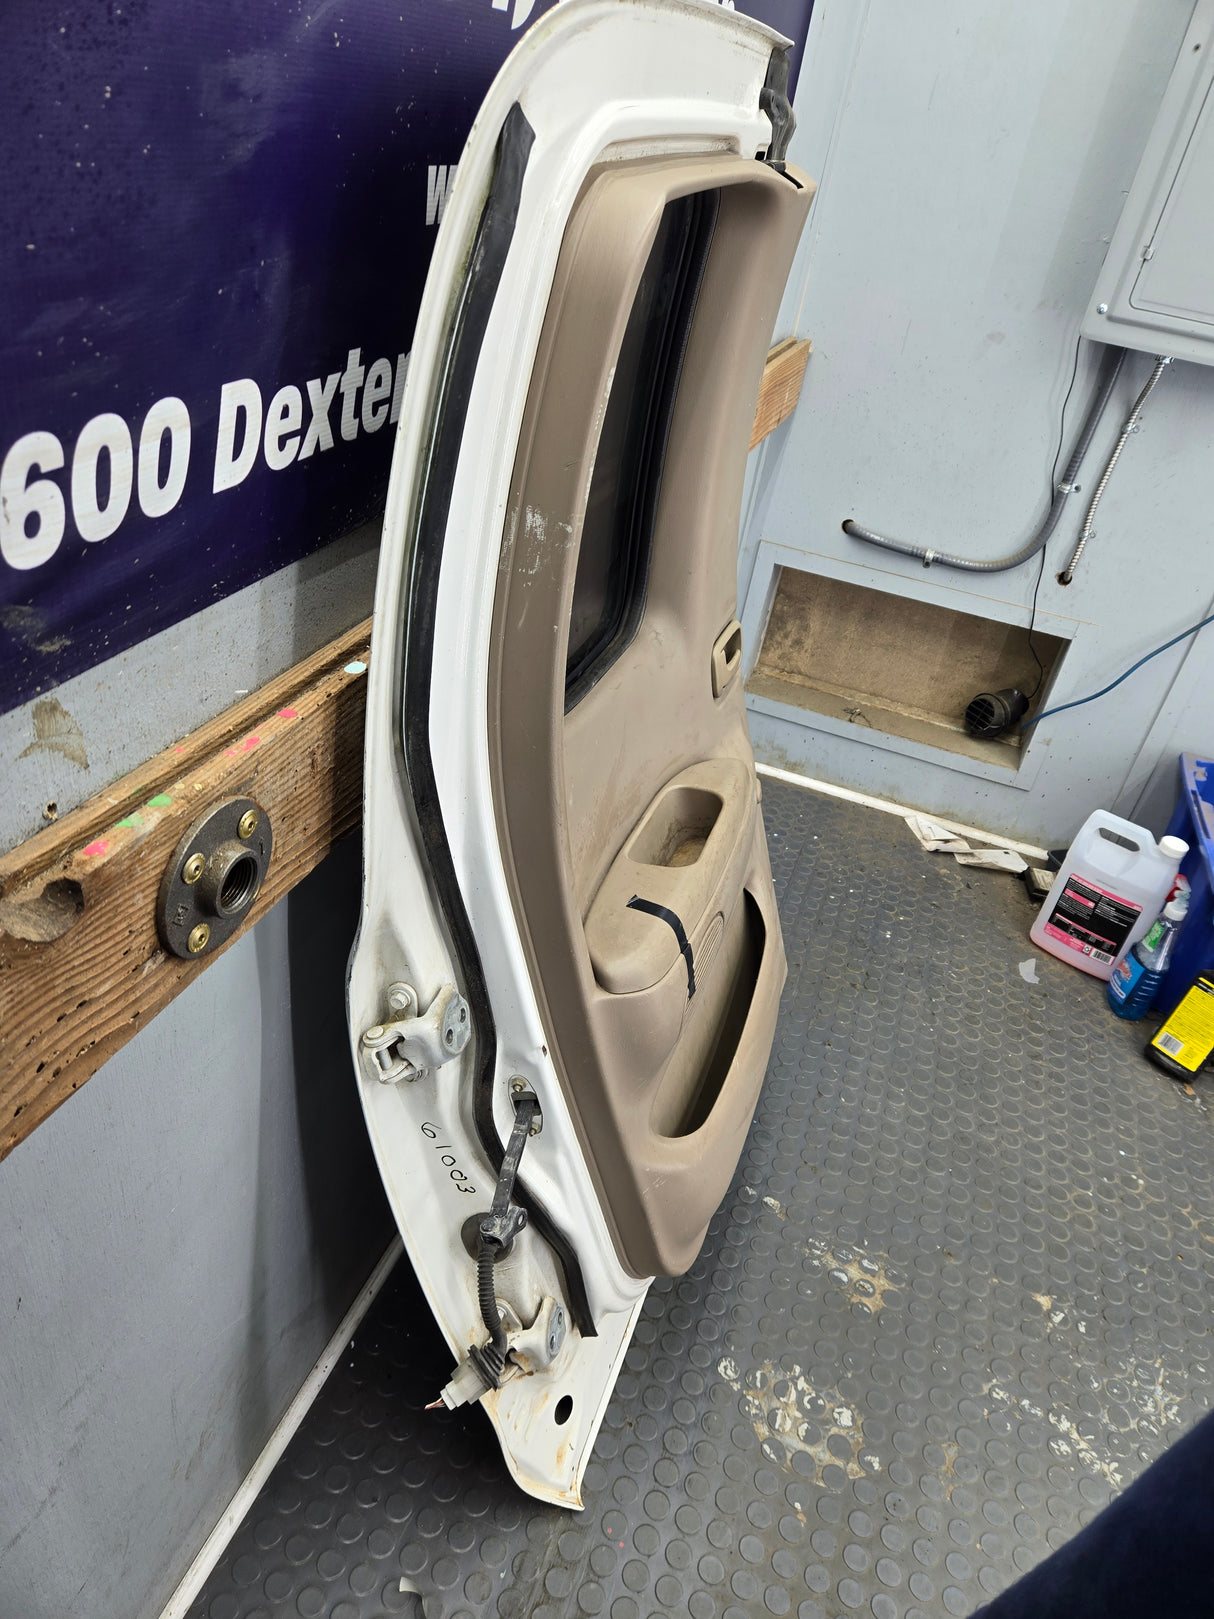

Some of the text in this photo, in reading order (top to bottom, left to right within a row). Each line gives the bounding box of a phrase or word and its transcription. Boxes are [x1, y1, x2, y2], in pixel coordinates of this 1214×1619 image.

[0, 346, 412, 571] 600 Dexter
[420, 1121, 476, 1194] 61003
